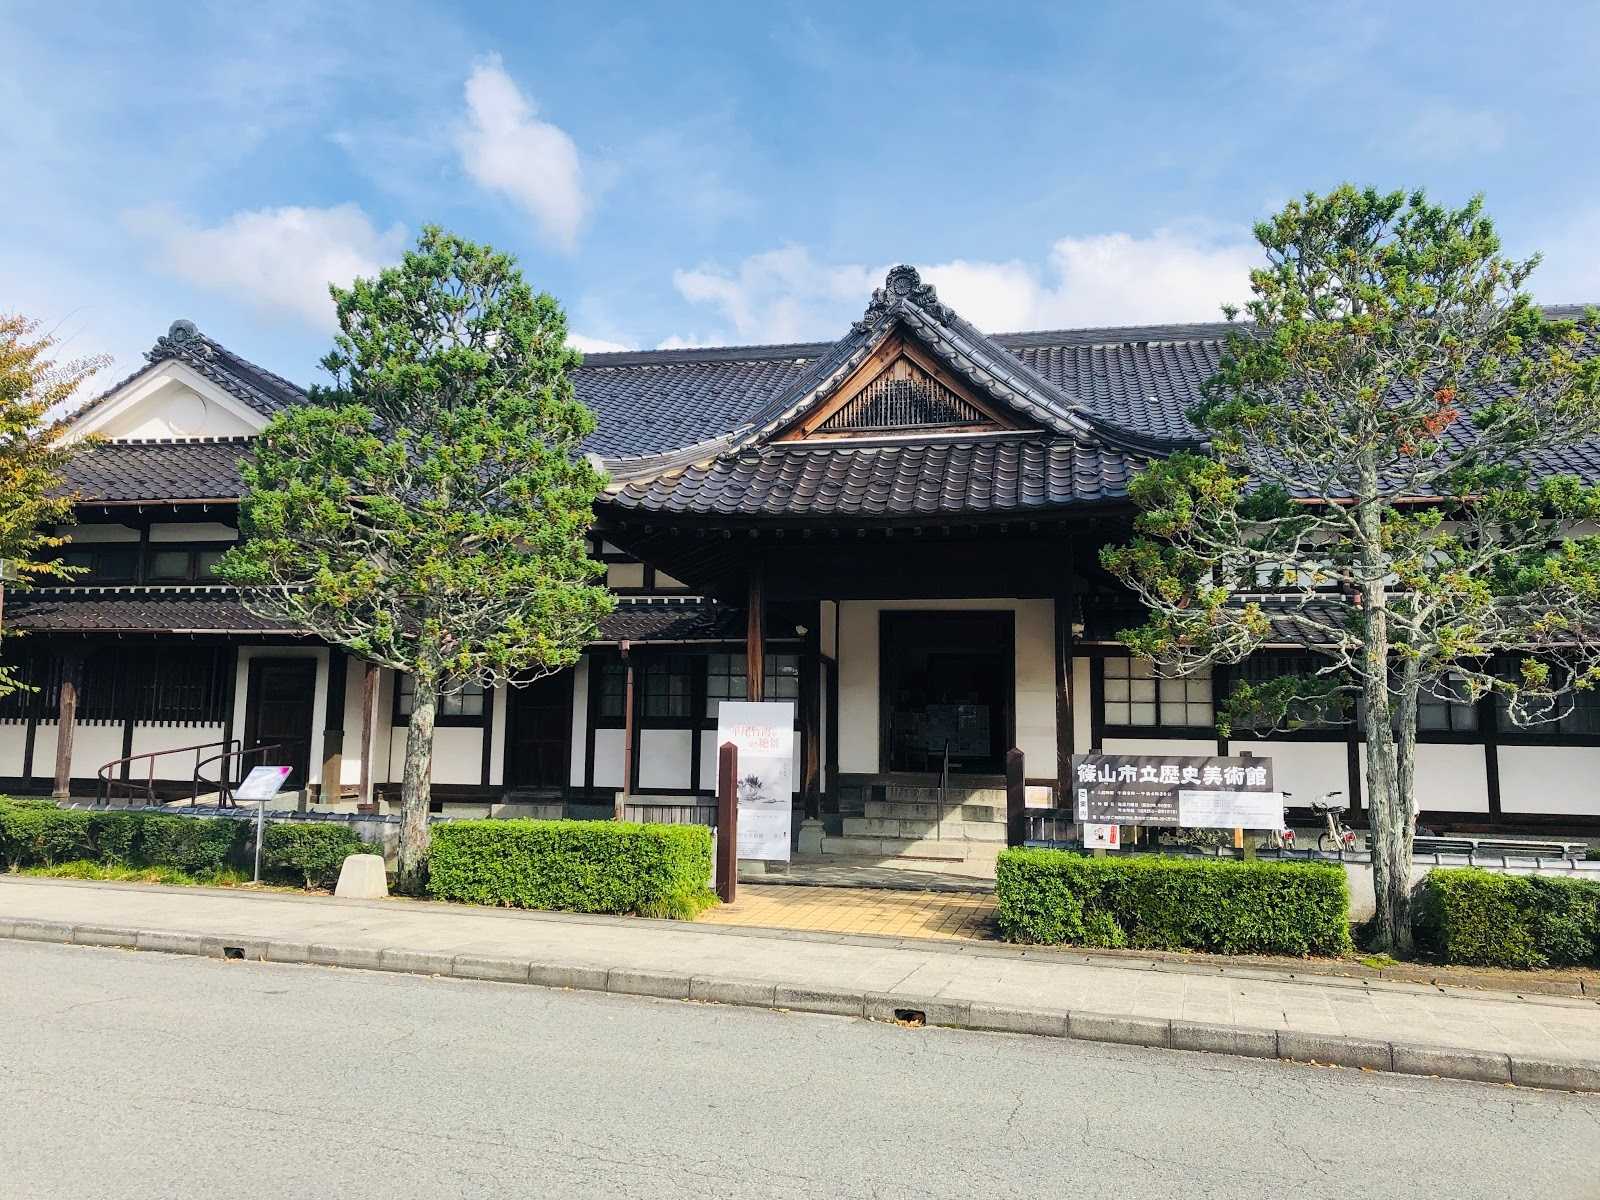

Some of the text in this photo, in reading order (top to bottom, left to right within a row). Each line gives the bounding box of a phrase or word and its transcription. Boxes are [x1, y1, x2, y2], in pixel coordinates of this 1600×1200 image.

[1077, 763, 1267, 786] 篠山市立歴史美術館
